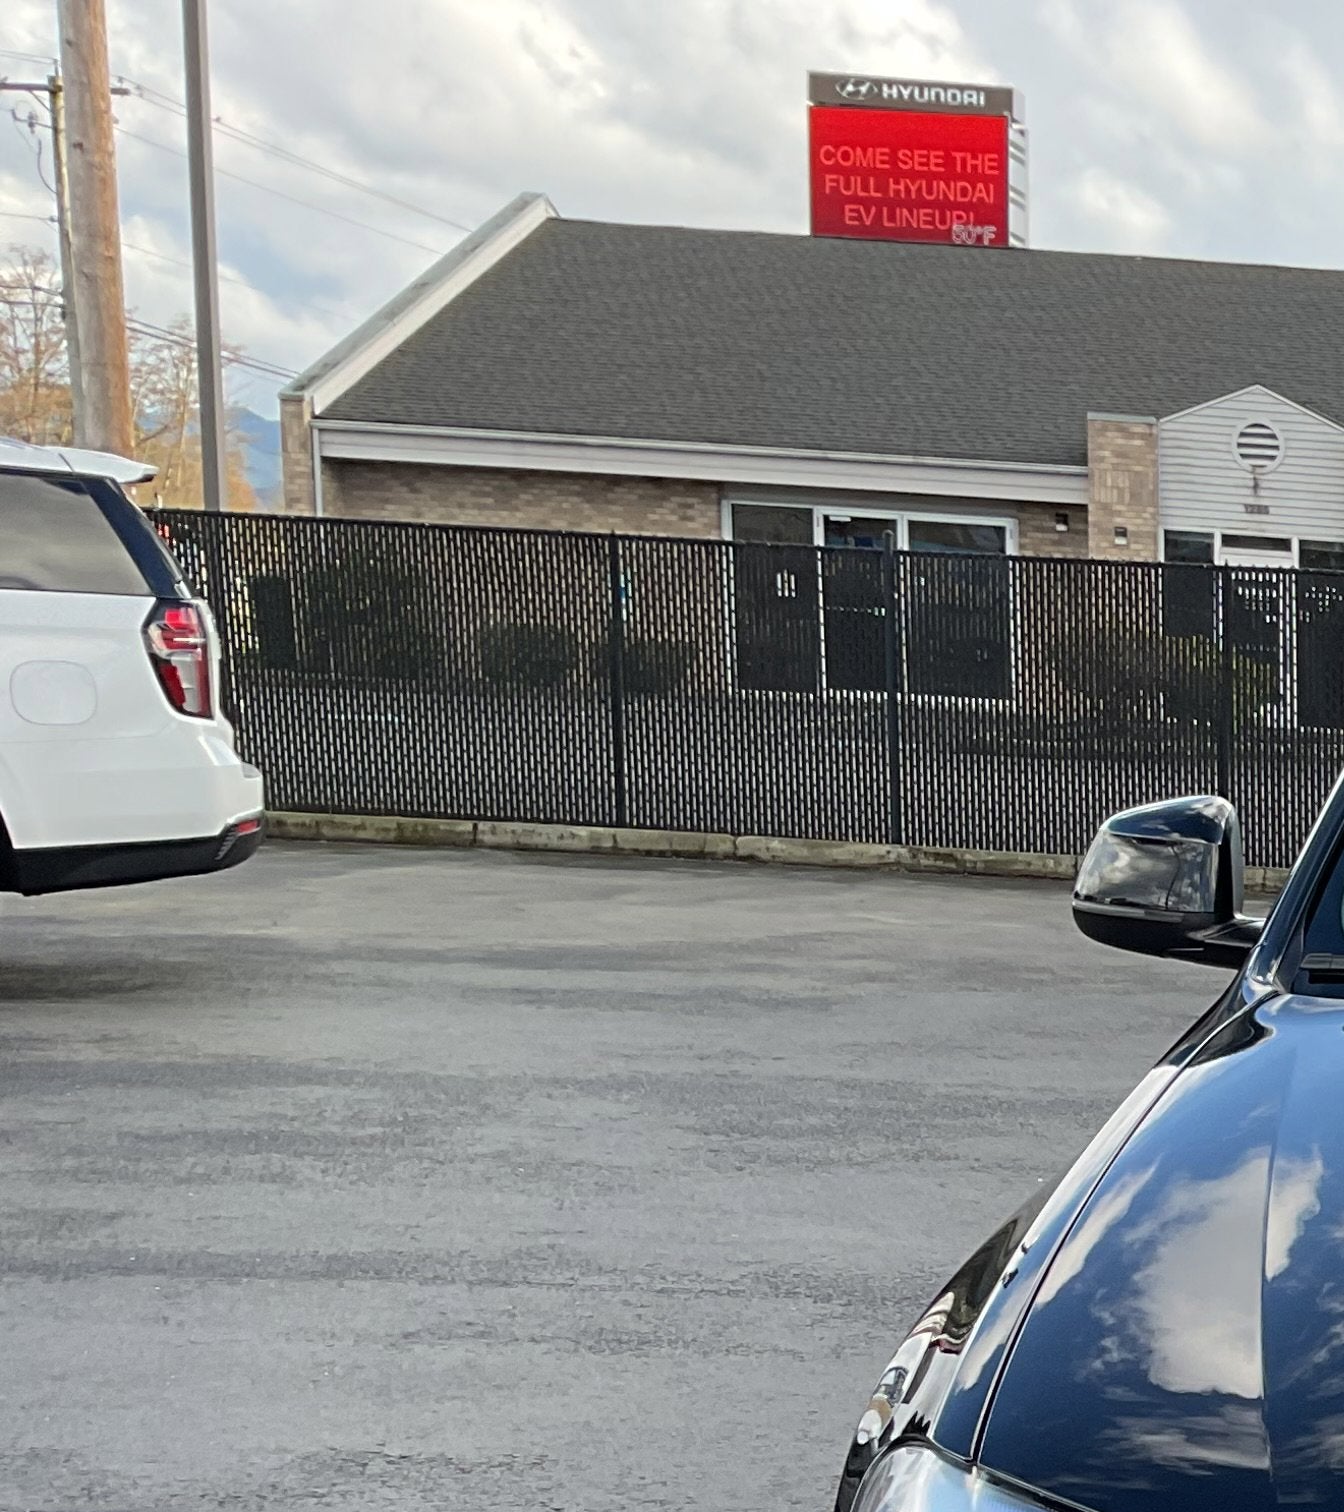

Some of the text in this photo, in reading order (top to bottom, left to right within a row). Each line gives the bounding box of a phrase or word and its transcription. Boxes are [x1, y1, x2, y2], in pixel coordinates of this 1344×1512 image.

[882, 83, 985, 107] HYUNDAI
[819, 145, 999, 175] COME SEE THE
[824, 174, 994, 203] FULL HYUNDAI
[844, 205, 876, 226] EV
